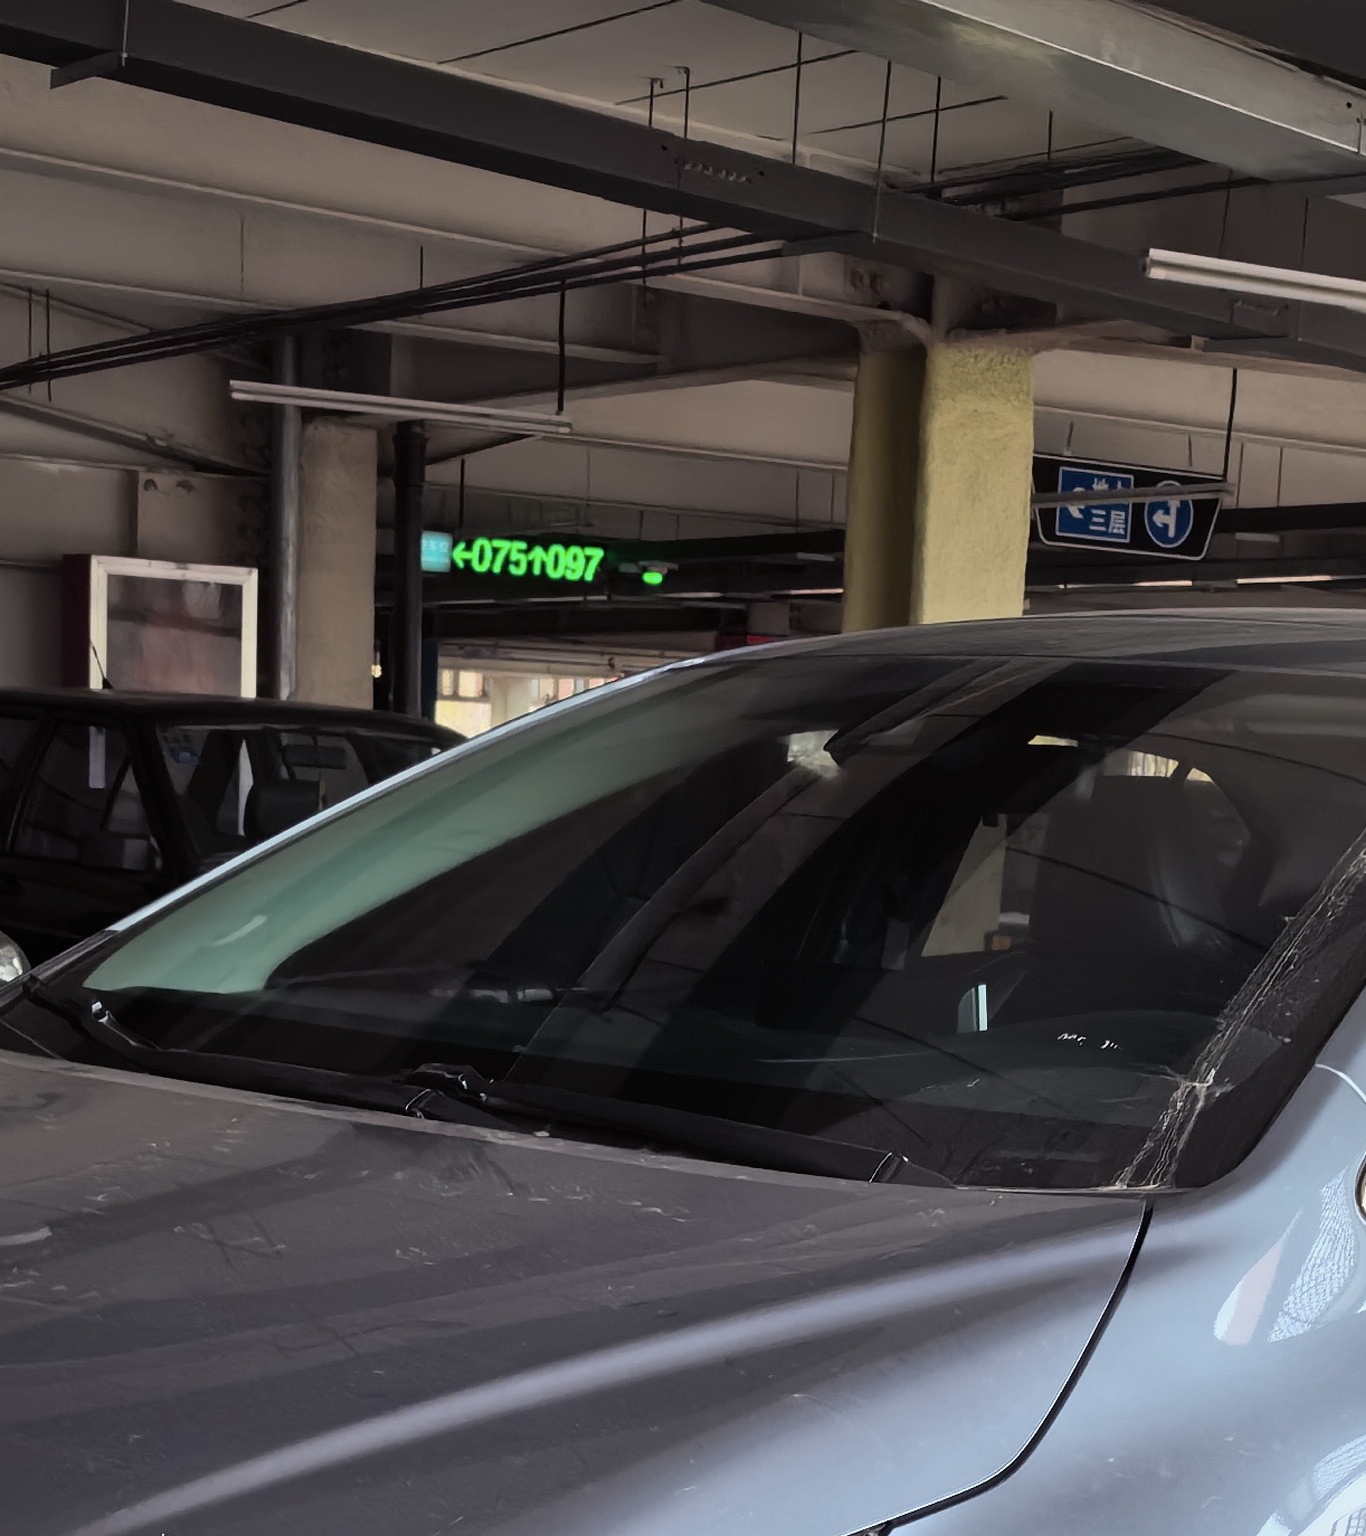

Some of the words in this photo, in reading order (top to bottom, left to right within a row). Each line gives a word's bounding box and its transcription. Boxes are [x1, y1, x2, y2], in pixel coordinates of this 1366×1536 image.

[1089, 509, 1126, 535] 三层
[471, 537, 528, 576] 075
[545, 544, 605, 582] 097
